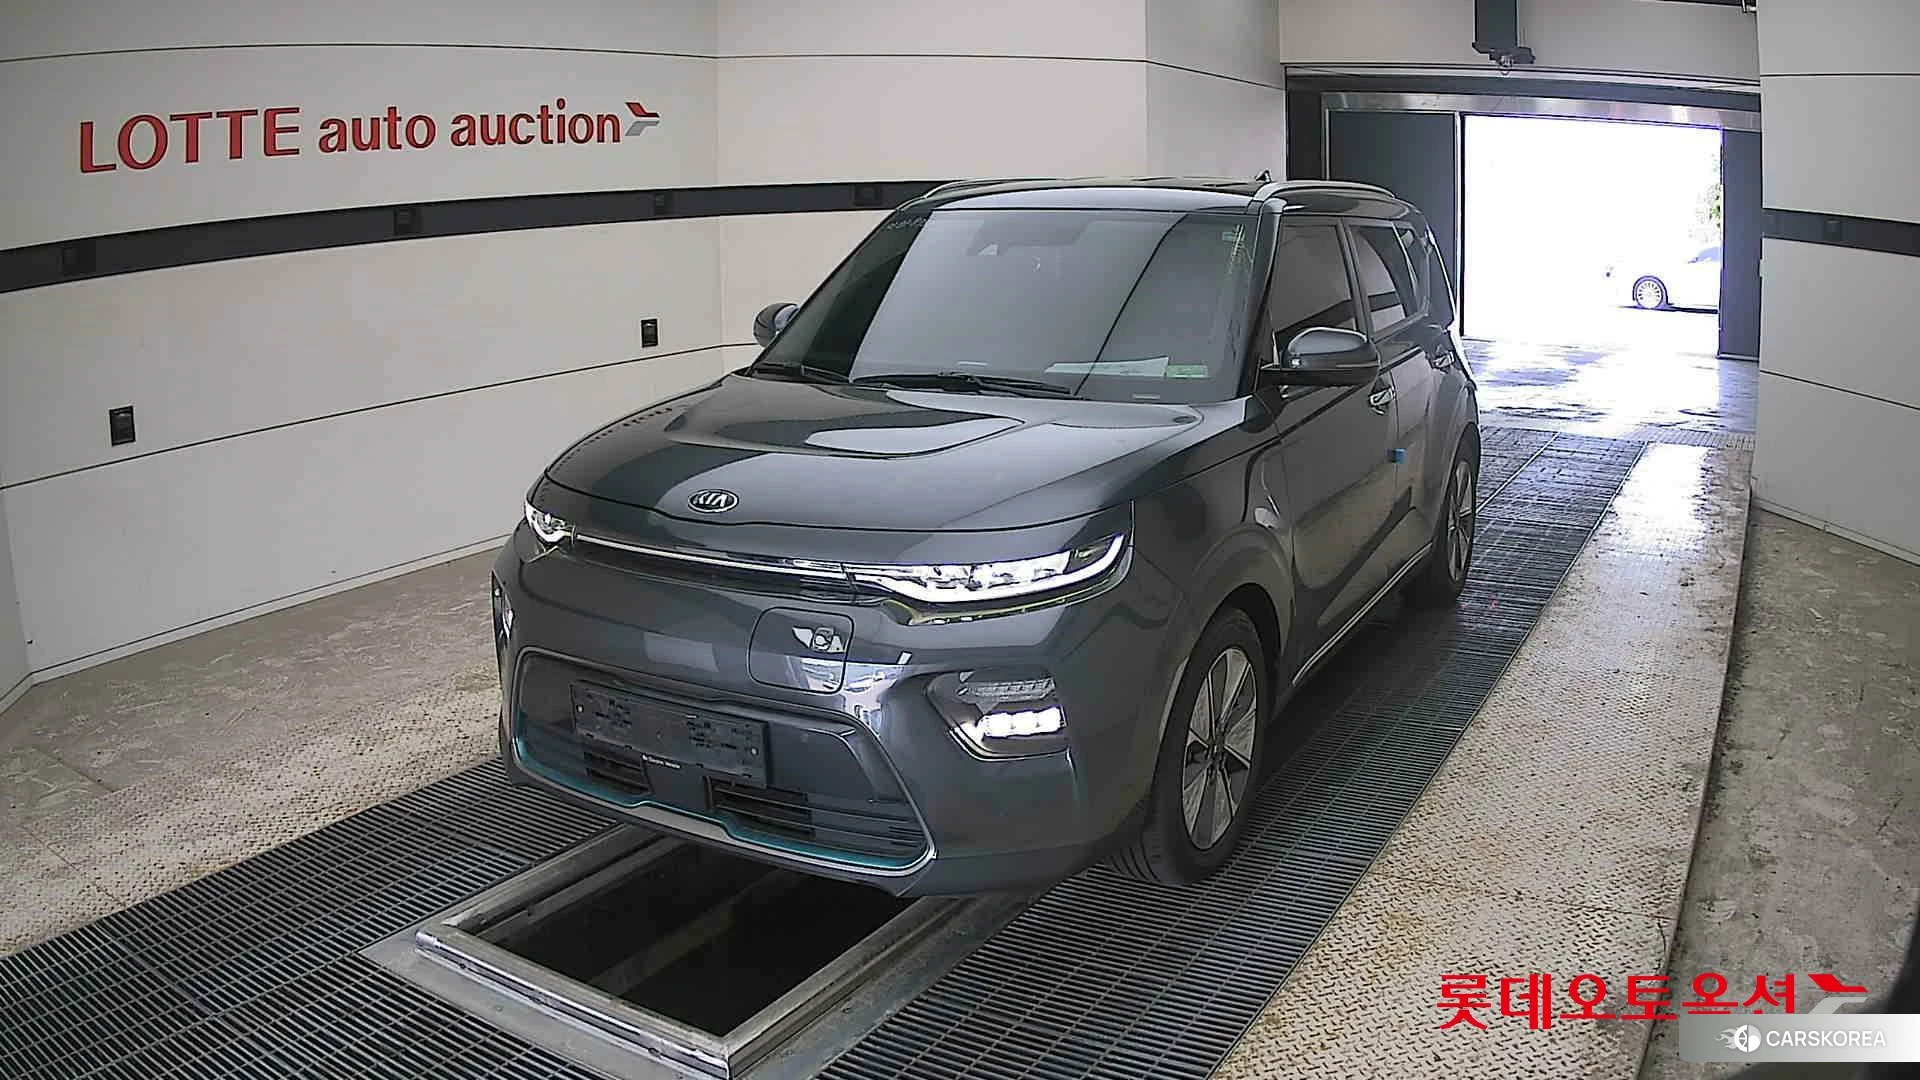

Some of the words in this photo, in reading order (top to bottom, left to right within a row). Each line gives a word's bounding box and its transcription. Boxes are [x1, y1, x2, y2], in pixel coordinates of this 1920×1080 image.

[79, 106, 300, 174] LOTTE
[318, 105, 437, 154] auto
[450, 97, 622, 147] auction
